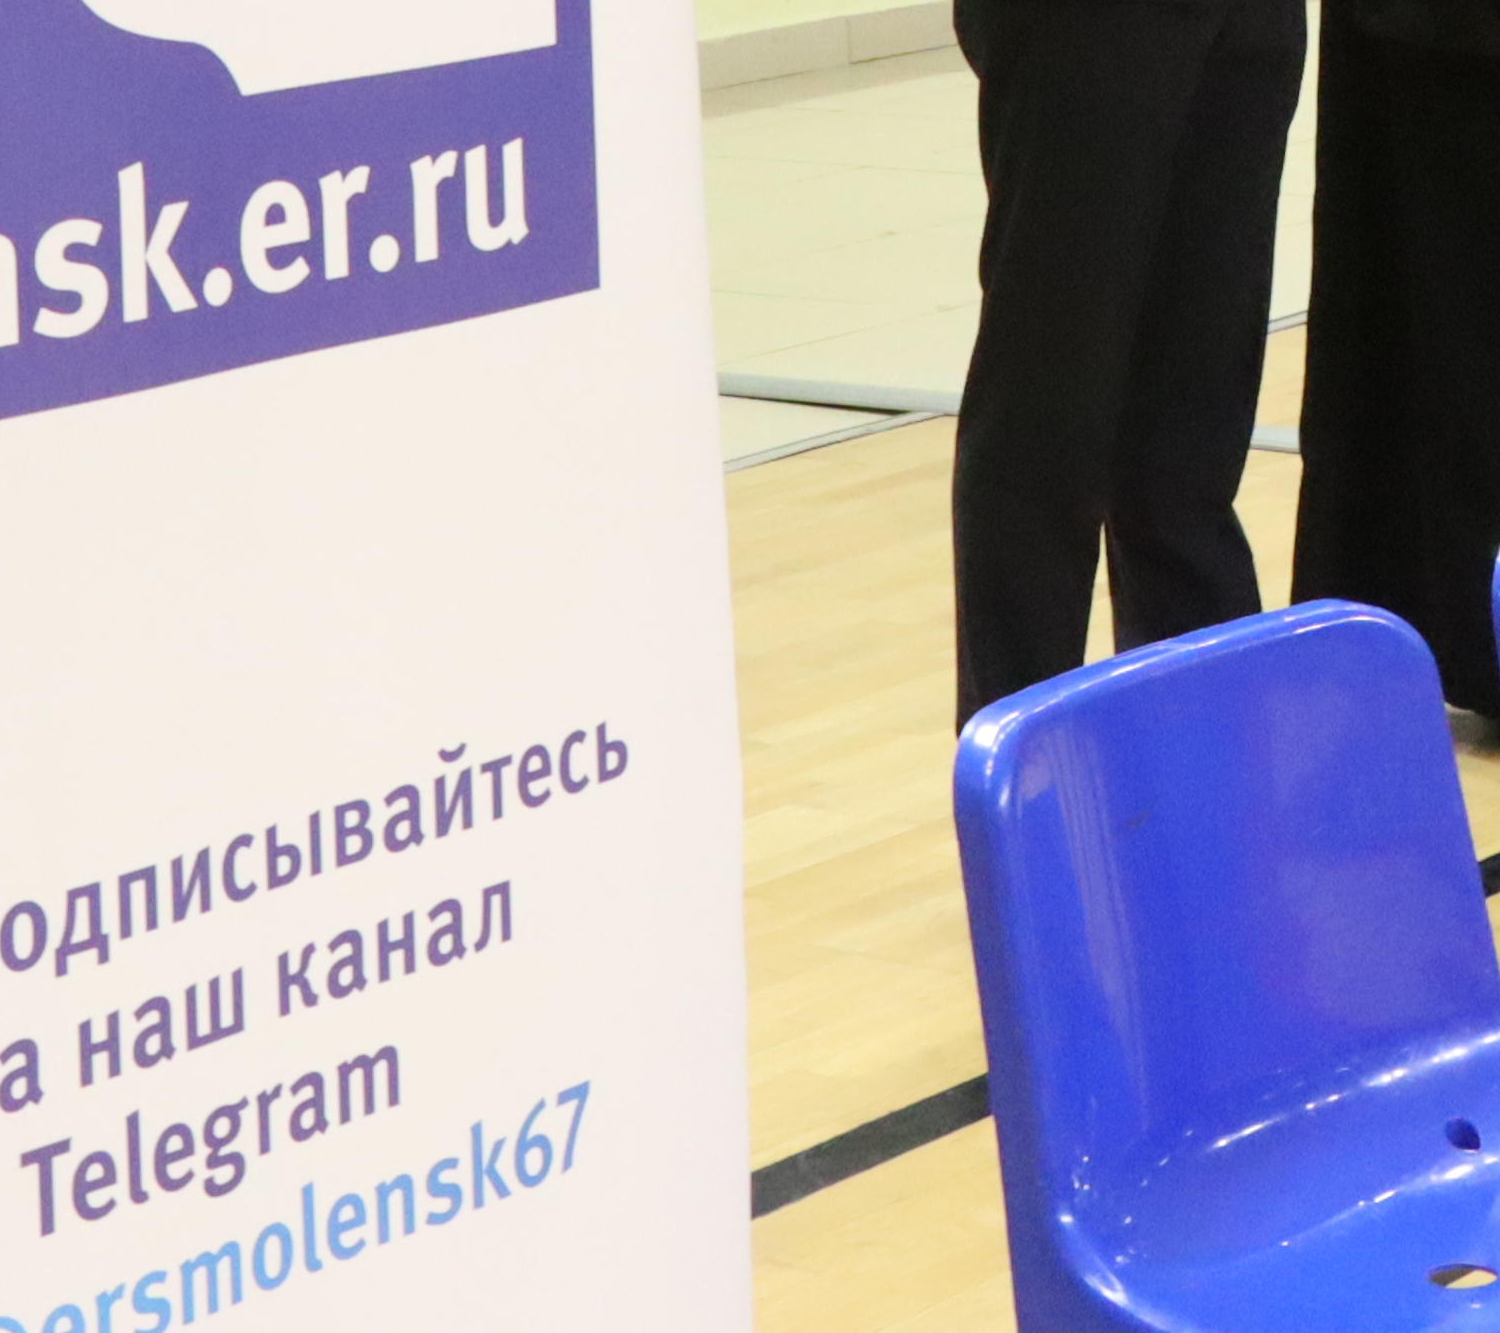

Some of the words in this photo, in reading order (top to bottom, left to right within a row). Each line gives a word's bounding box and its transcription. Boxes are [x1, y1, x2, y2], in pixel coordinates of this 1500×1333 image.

[78, 967, 246, 1089] наш
[276, 879, 513, 1019] канал
[19, 1043, 401, 1239] Telegram
